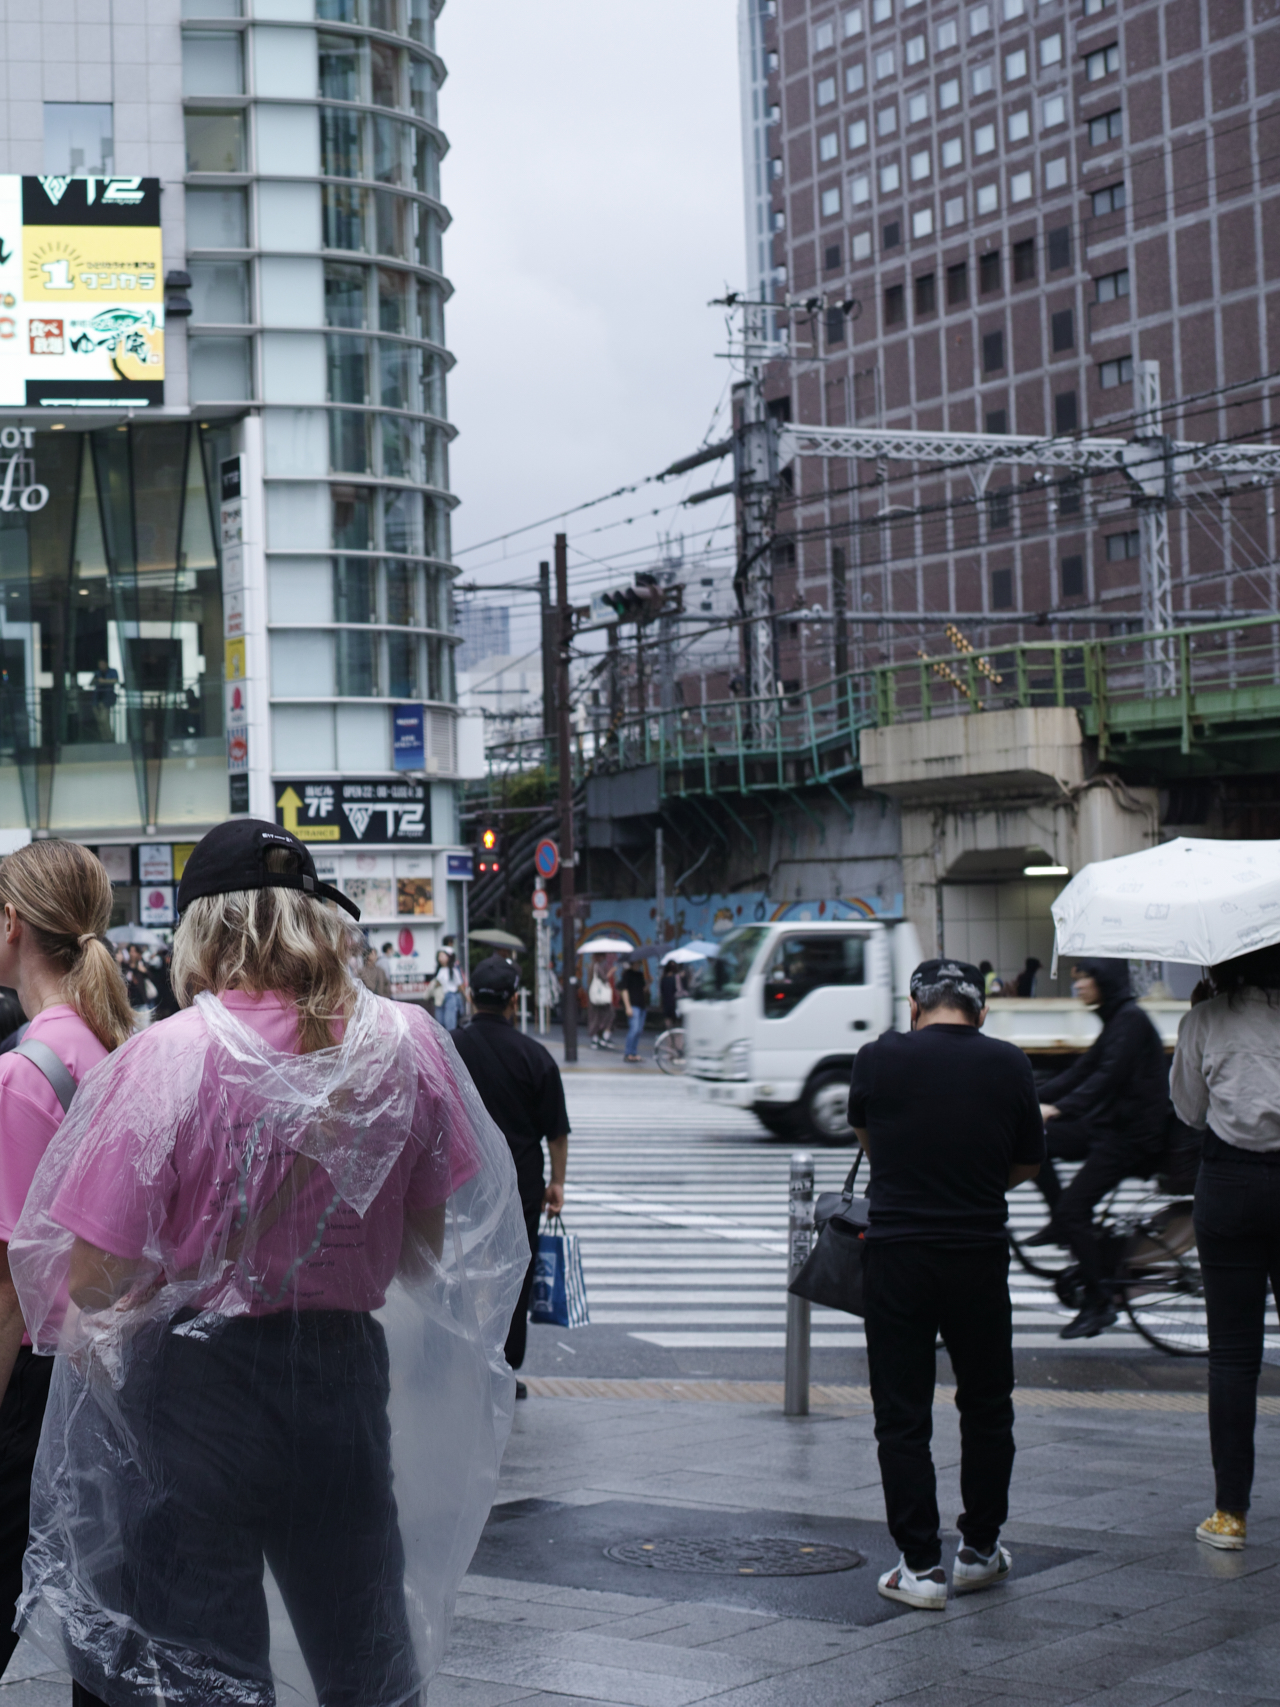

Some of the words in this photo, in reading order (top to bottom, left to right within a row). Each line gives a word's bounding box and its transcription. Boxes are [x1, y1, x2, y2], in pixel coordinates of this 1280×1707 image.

[80, 272, 156, 290] ワンカラ
[304, 797, 334, 817] 7F
[294, 828, 335, 838] NTRANCE
